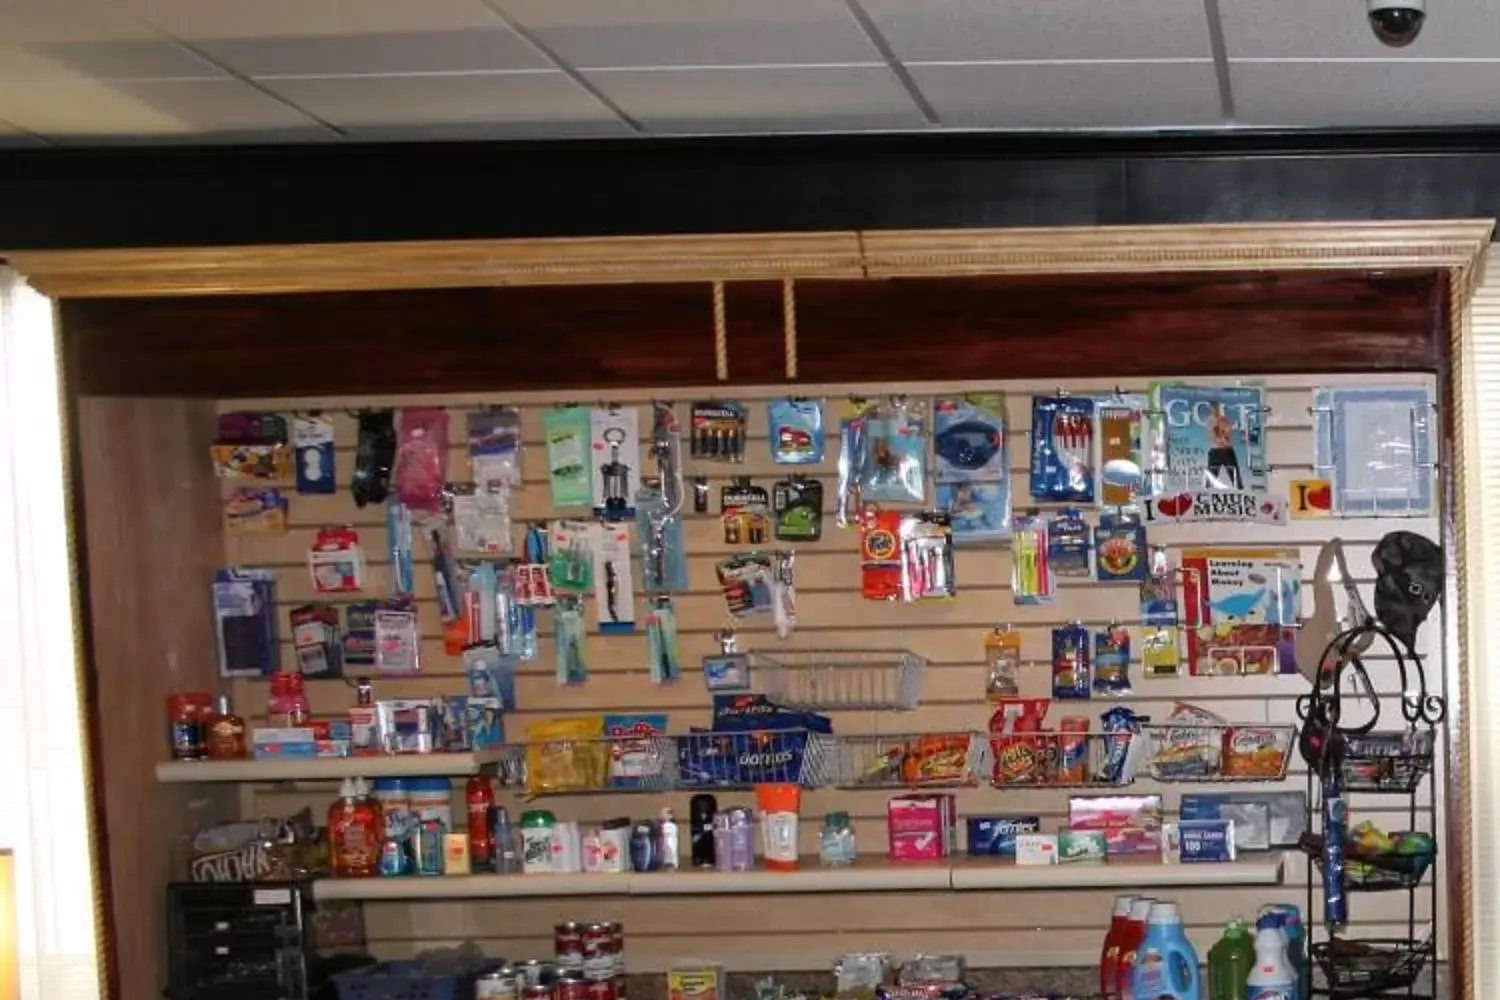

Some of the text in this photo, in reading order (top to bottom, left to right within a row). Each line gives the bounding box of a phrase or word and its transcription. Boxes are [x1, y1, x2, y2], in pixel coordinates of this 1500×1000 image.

[1165, 399, 1257, 431] GOLF
[1297, 485, 1308, 511] I
[1144, 500, 1156, 521] I
[1194, 502, 1258, 517] MUSIC
[1209, 560, 1253, 568] Learning
[1211, 579, 1243, 587] Money
